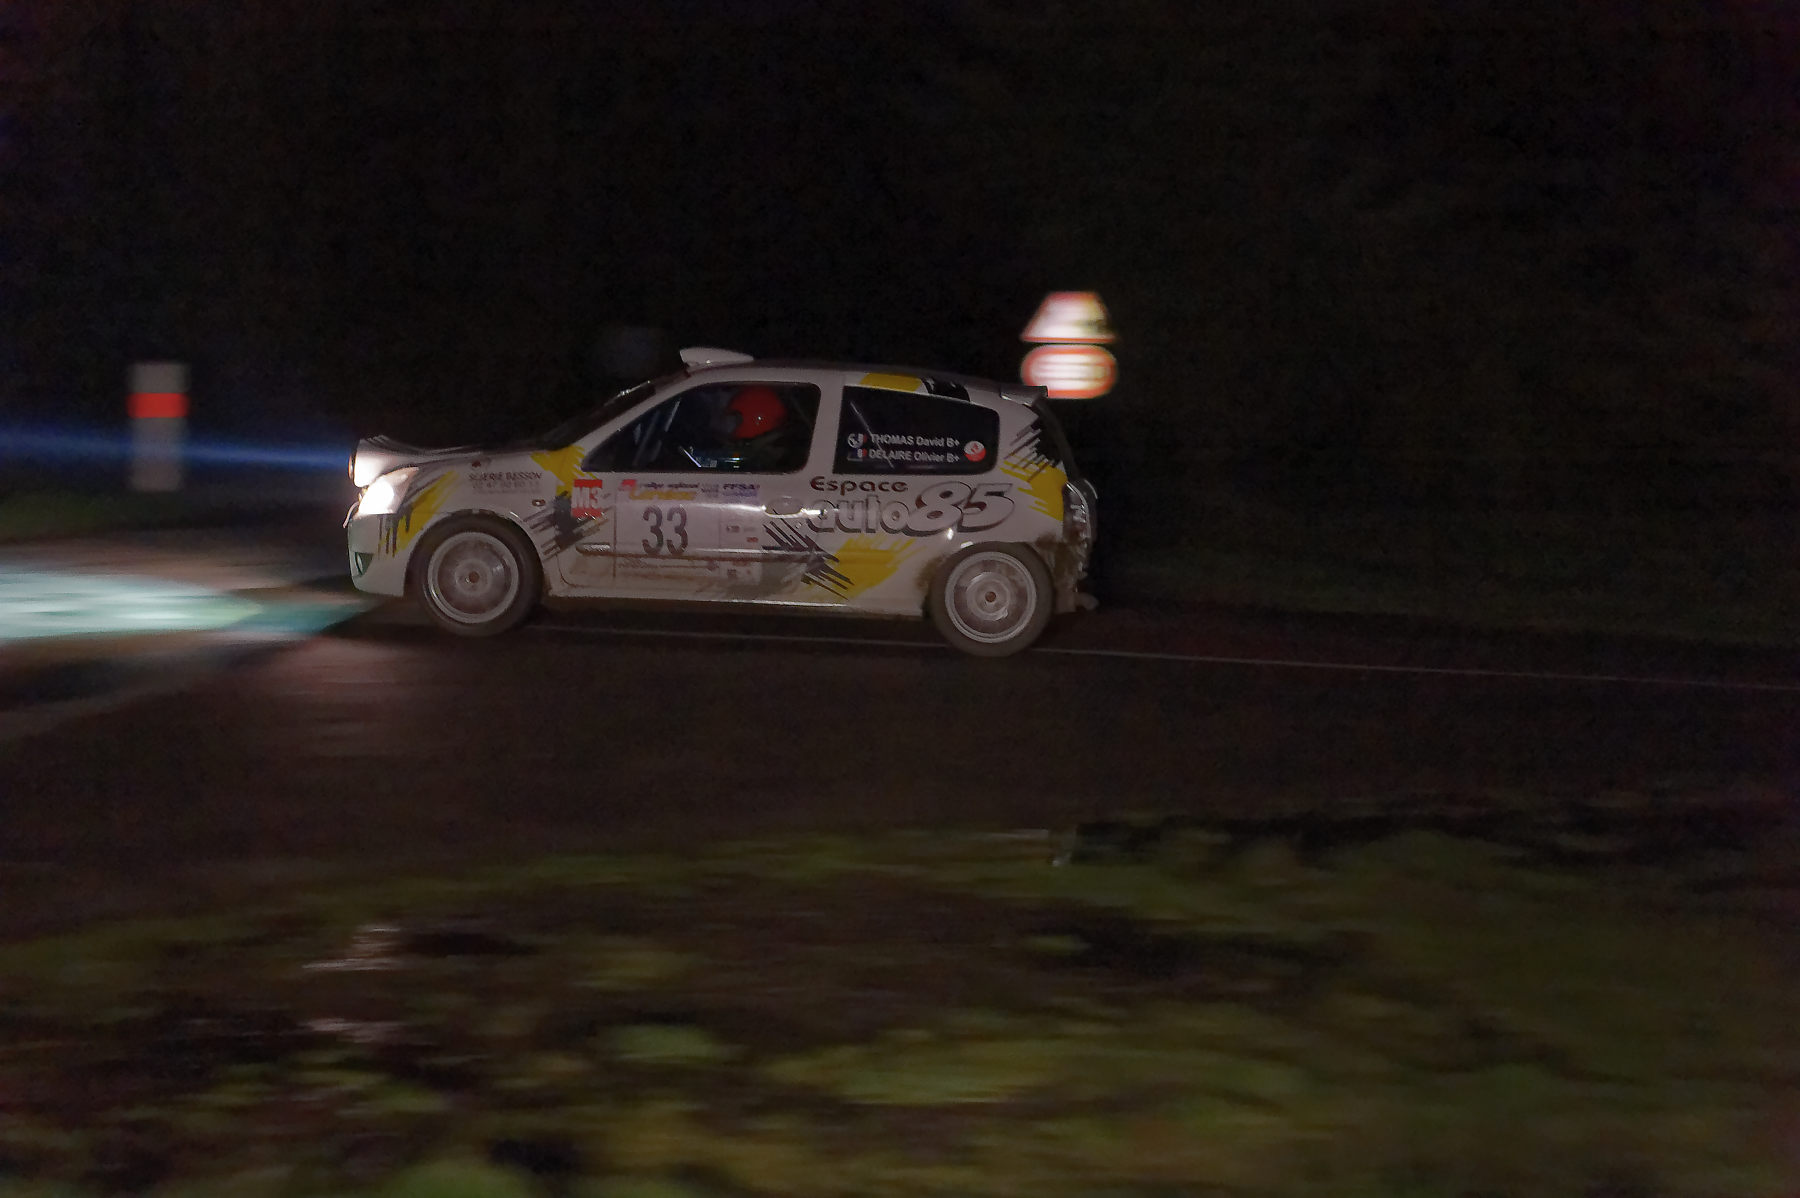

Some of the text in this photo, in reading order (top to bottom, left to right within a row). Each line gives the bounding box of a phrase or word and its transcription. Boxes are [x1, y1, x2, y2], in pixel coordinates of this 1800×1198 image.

[871, 433, 960, 448] THOMAS David B+
[869, 449, 960, 463] DELAIRE Olivier B+
[809, 476, 909, 496] Espace
[642, 506, 689, 555] 33
